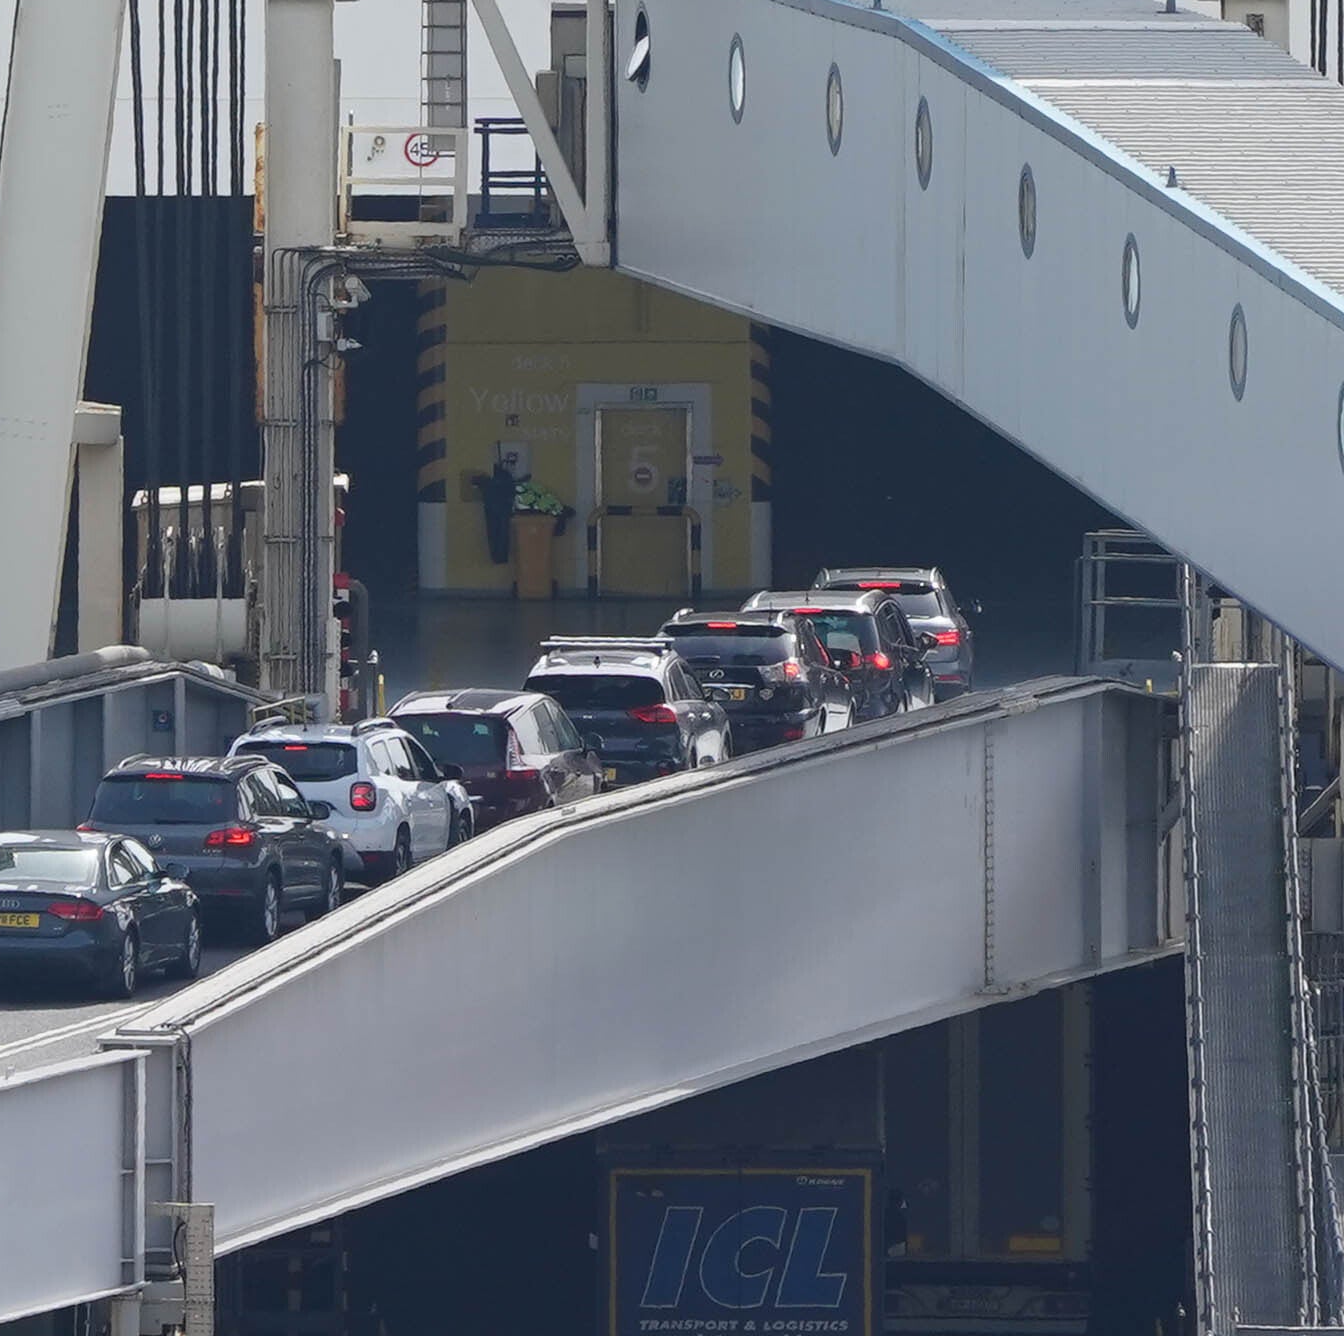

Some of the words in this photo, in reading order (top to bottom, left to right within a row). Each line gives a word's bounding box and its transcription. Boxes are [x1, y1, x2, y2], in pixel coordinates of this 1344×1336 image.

[468, 386, 569, 414] Yellow
[640, 1205, 848, 1309] ICL
[639, 1319, 738, 1331] TRANSPORT
[743, 1320, 756, 1331] &
[763, 1320, 849, 1331] LOGISTICS
